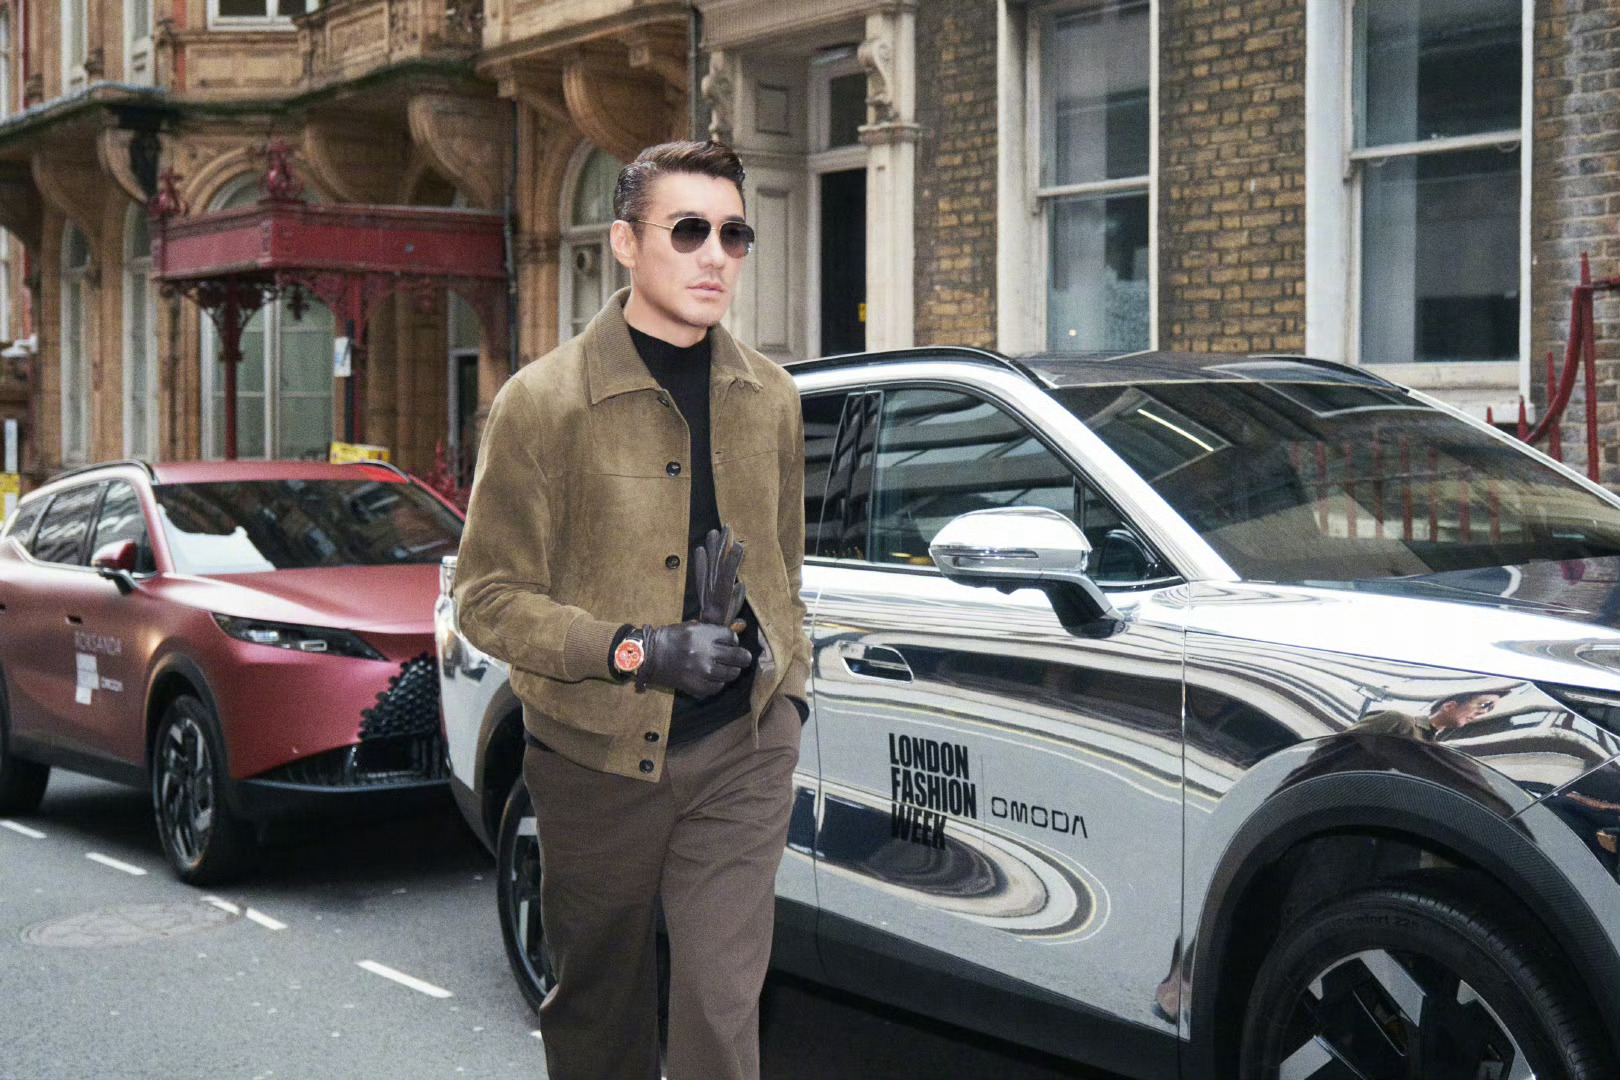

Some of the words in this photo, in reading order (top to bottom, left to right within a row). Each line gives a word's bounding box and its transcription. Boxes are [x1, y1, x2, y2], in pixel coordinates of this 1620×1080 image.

[889, 733, 970, 780] LONDON
[891, 766, 977, 820] FASHION
[891, 803, 948, 851] WEEK
[991, 796, 1088, 839] OMODA
